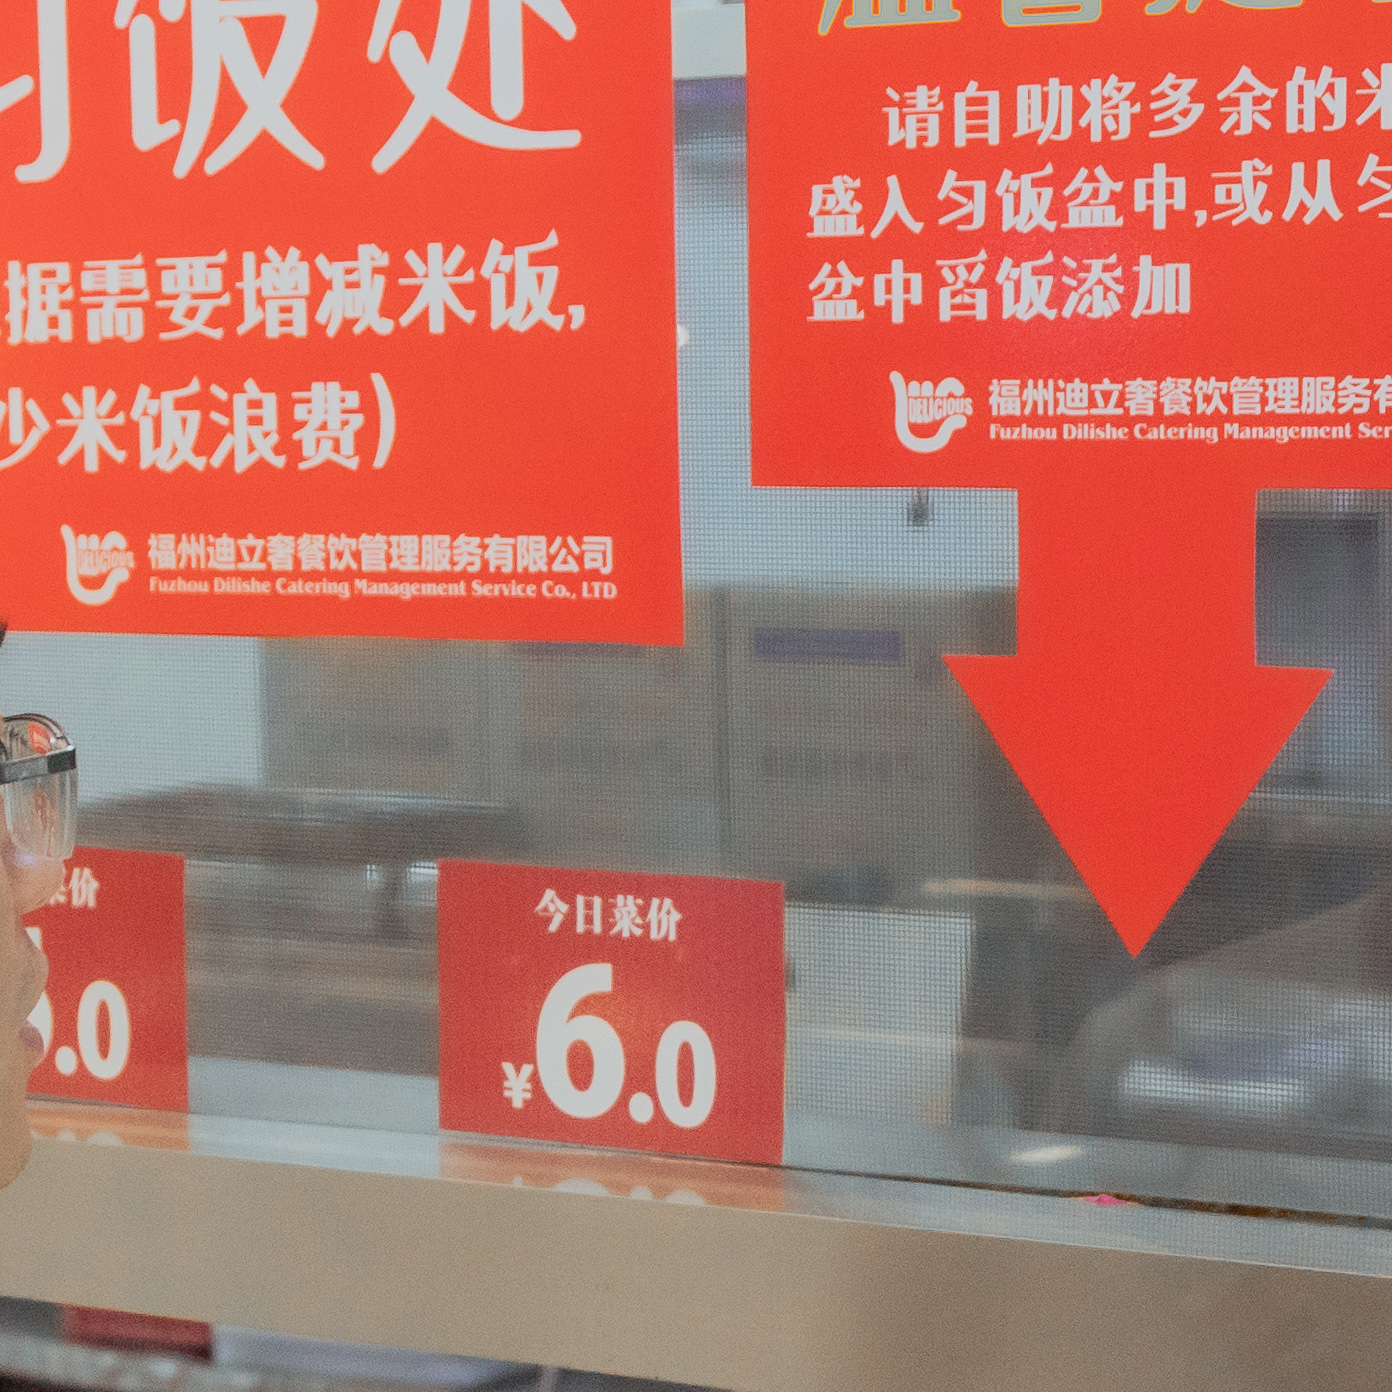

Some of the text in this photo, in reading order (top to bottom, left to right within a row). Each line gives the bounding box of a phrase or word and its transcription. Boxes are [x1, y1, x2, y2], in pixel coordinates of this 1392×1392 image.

[807, 249, 1191, 324] 盆中舀饭添加
[908, 397, 973, 423] DELICIOUS
[989, 423, 1058, 440] Fuzhou
[1062, 423, 1128, 440] Dilishe
[1133, 423, 1219, 444] Catering
[1223, 422, 1351, 443] Management
[148, 533, 613, 574] 福州迪立奢餐饮管理服务有限公司
[149, 574, 618, 600] Fuzhou Dilishe Catering Management Service Co., LTD
[535, 888, 683, 943] 今日菜价
[501, 962, 717, 1129] ¥6.0
